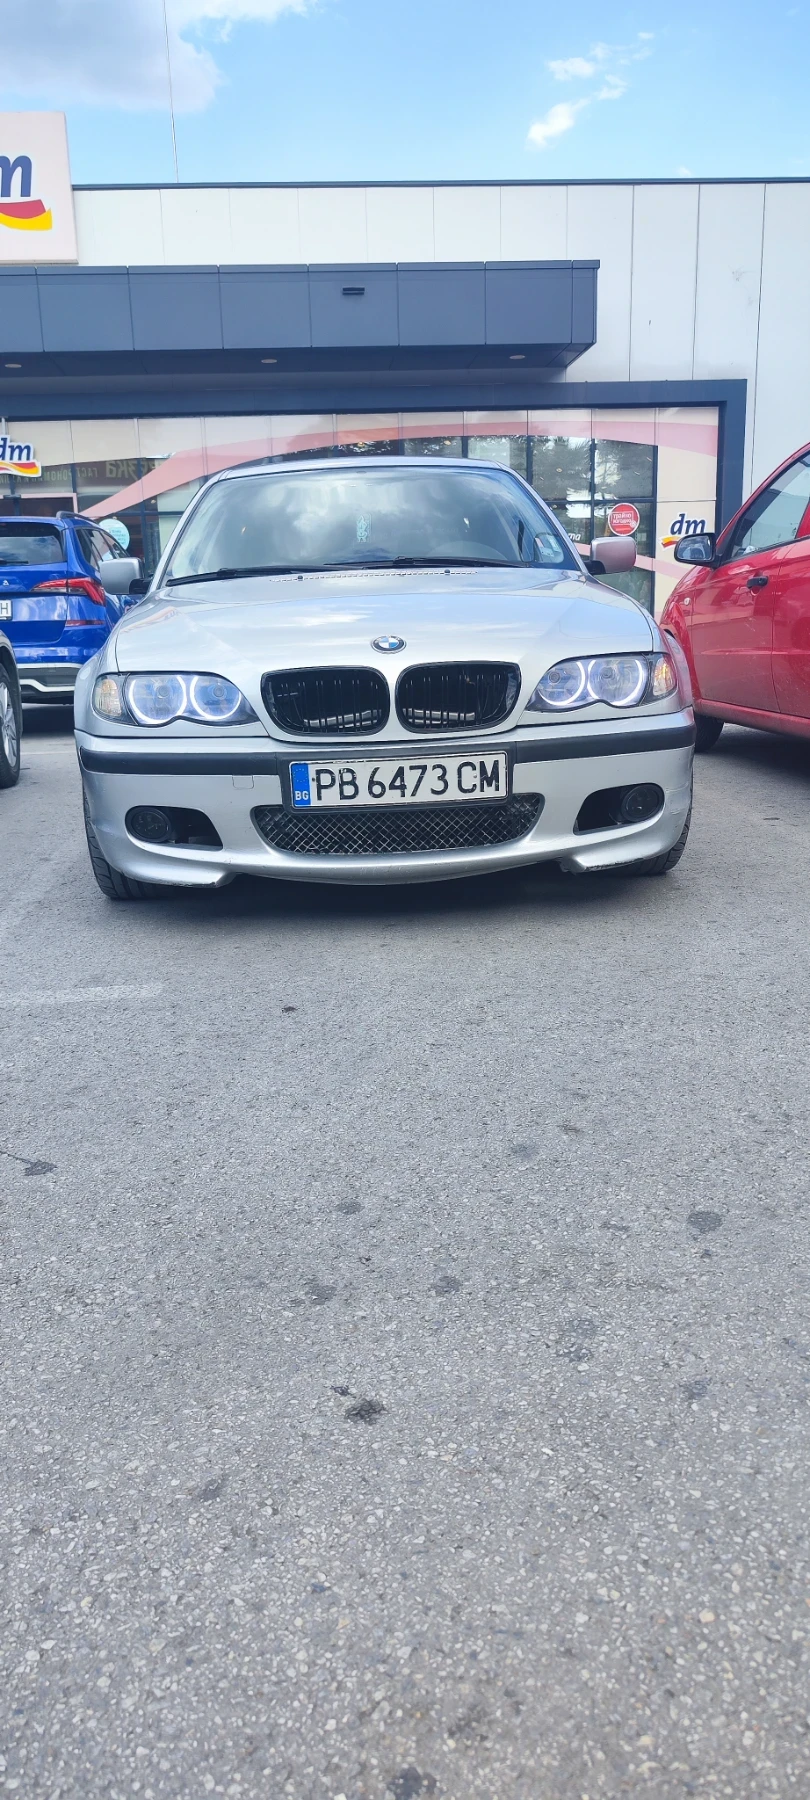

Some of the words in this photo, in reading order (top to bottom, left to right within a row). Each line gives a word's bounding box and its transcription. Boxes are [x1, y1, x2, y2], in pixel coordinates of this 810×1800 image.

[0, 155, 32, 197] m
[670, 513, 706, 535] dm
[0, 602, 8, 615] H
[315, 768, 360, 801] PB
[367, 763, 449, 799] 6473
[456, 759, 500, 794] CM
[294, 790, 309, 801] BG
